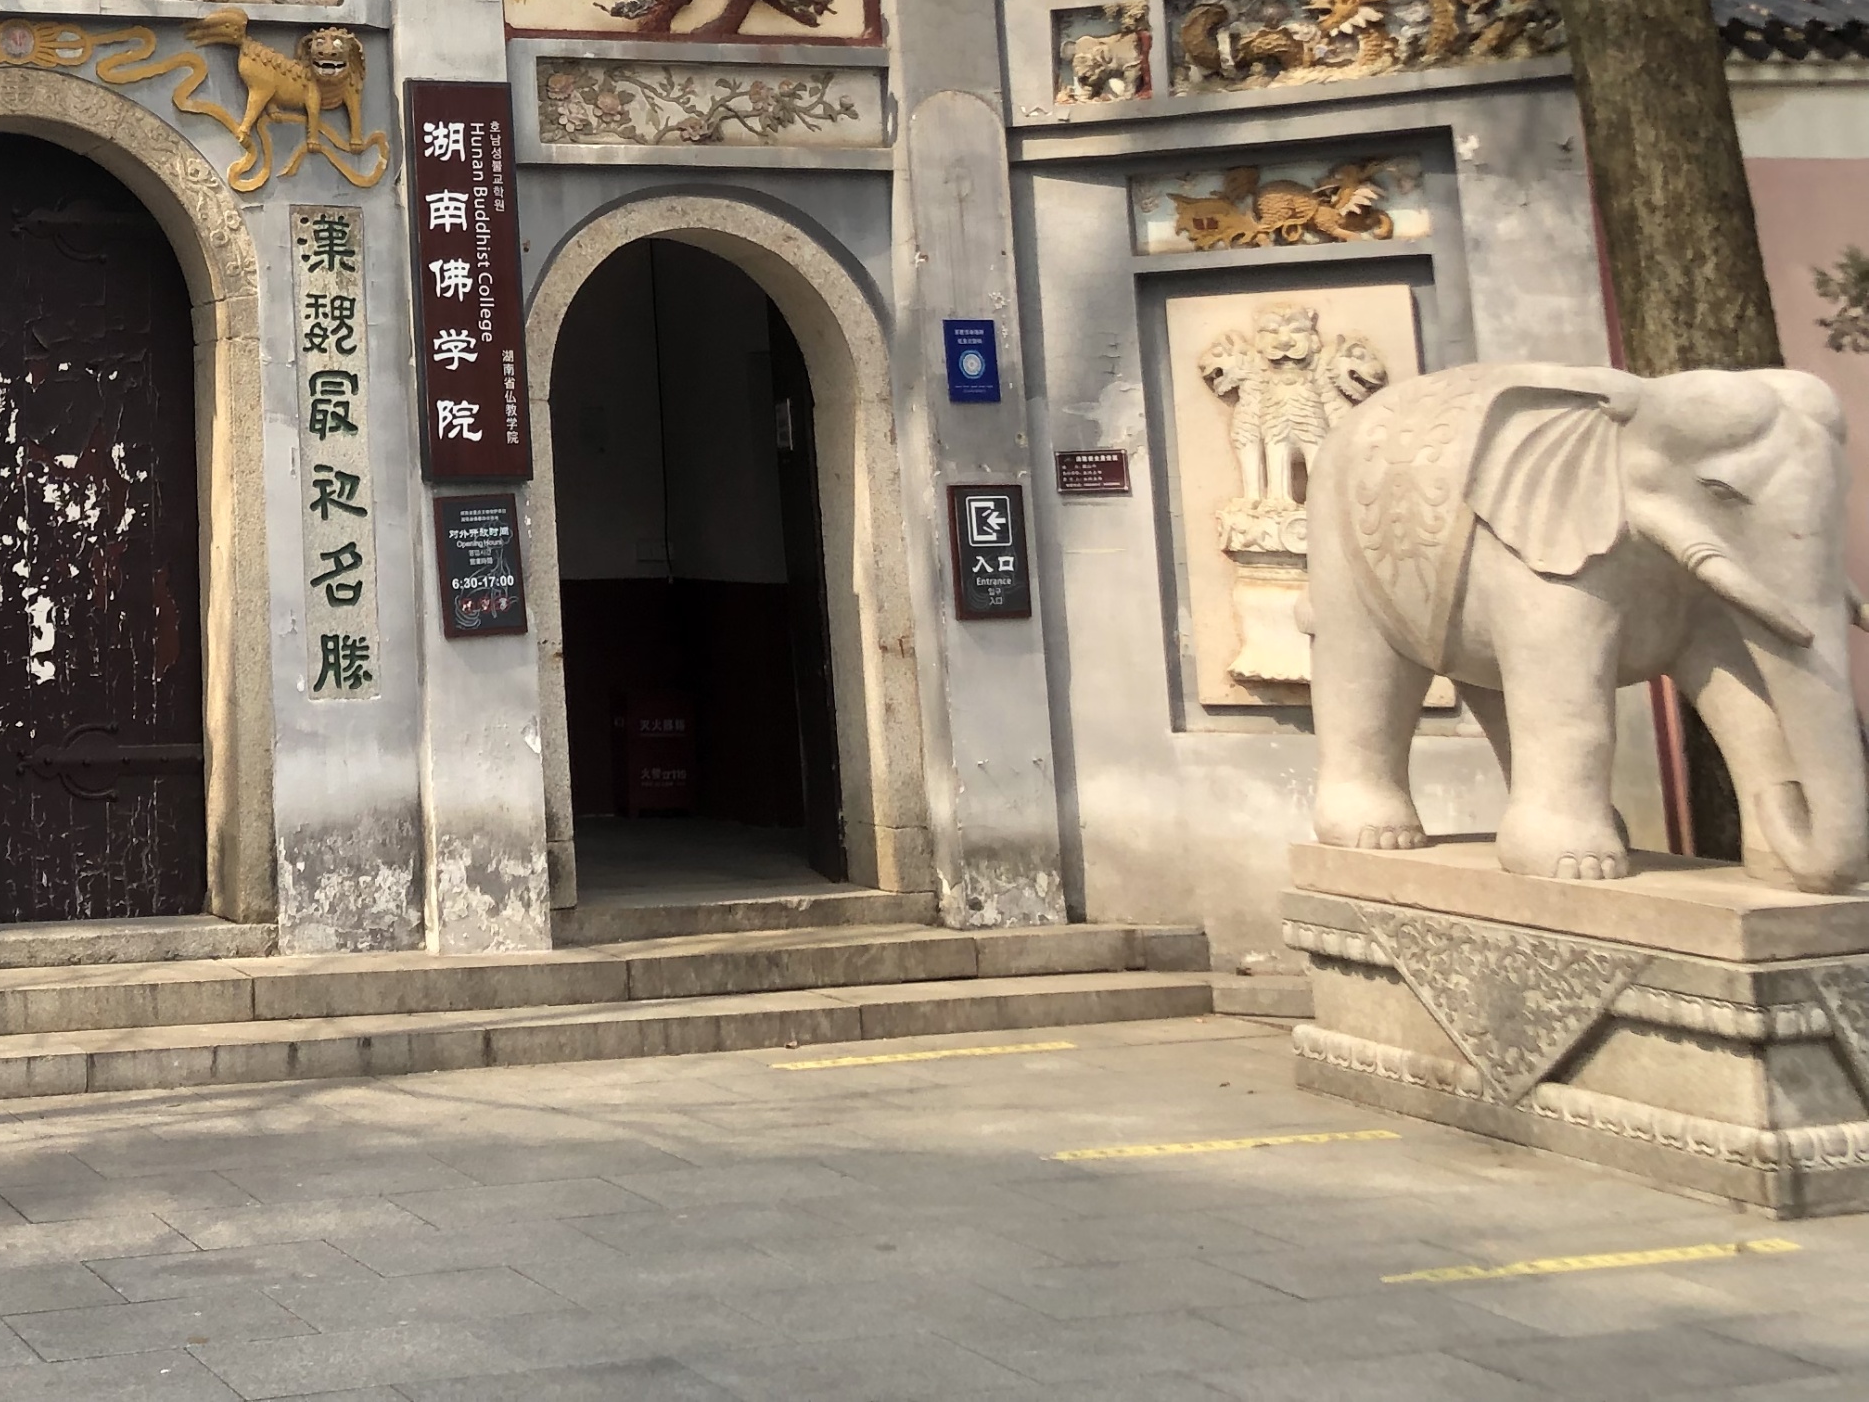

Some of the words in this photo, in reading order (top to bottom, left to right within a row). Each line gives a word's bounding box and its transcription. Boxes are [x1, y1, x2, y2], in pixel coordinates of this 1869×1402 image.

[470, 123, 485, 181] Hunan
[473, 186, 491, 268] Buddhist
[423, 121, 482, 442] 湖南佛学院
[478, 272, 495, 343] College
[456, 540, 483, 548] Opening
[972, 555, 1014, 572] 入口
[452, 575, 514, 589] 6:30-17:00
[976, 577, 1011, 586] Entrance
[989, 597, 1003, 605] 入口
